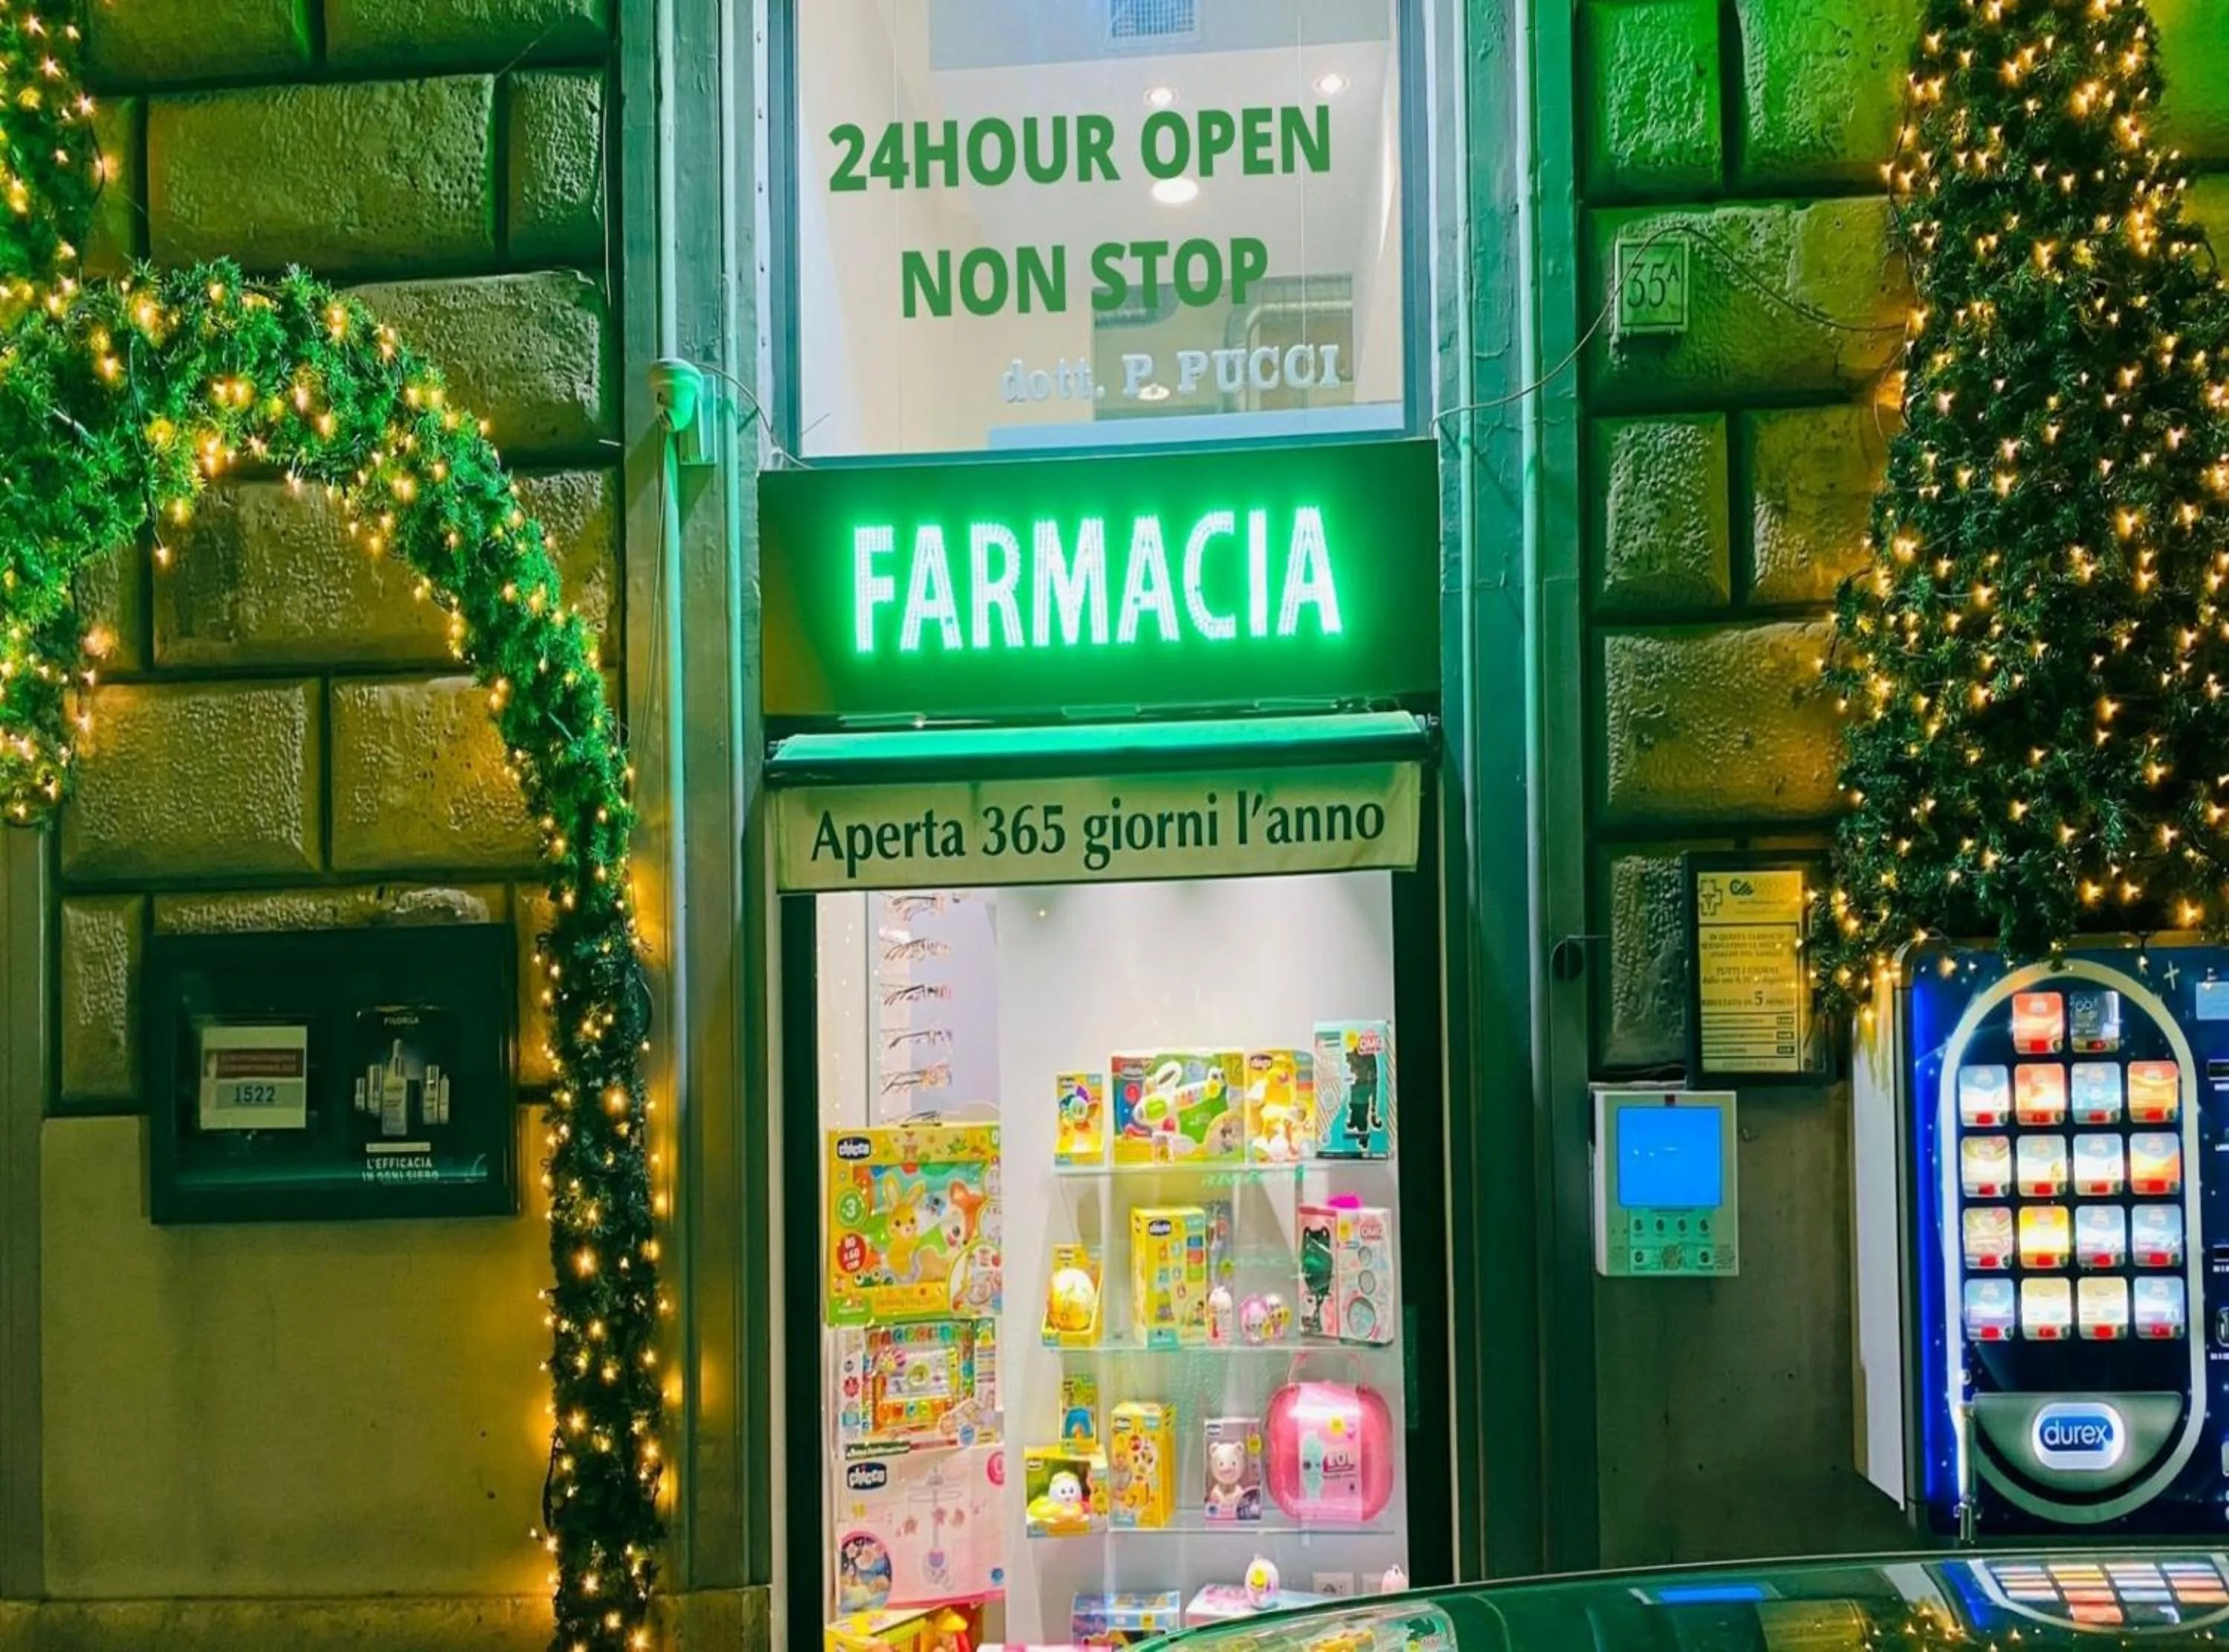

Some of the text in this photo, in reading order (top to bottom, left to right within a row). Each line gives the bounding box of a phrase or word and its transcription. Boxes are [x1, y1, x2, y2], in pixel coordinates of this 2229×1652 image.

[828, 105, 1331, 192] 24HOUR OPEN
[901, 237, 1268, 319] NON STOP
[1000, 358, 1106, 402] dott.
[1176, 344, 1340, 394] PUCCI
[853, 505, 1343, 654] FARMACIA
[811, 790, 1384, 879] Aperta 365 giorni l'anno
[1754, 990, 1764, 1006] 5
[234, 1085, 276, 1103] 1522
[2044, 1419, 2108, 1446] durex
